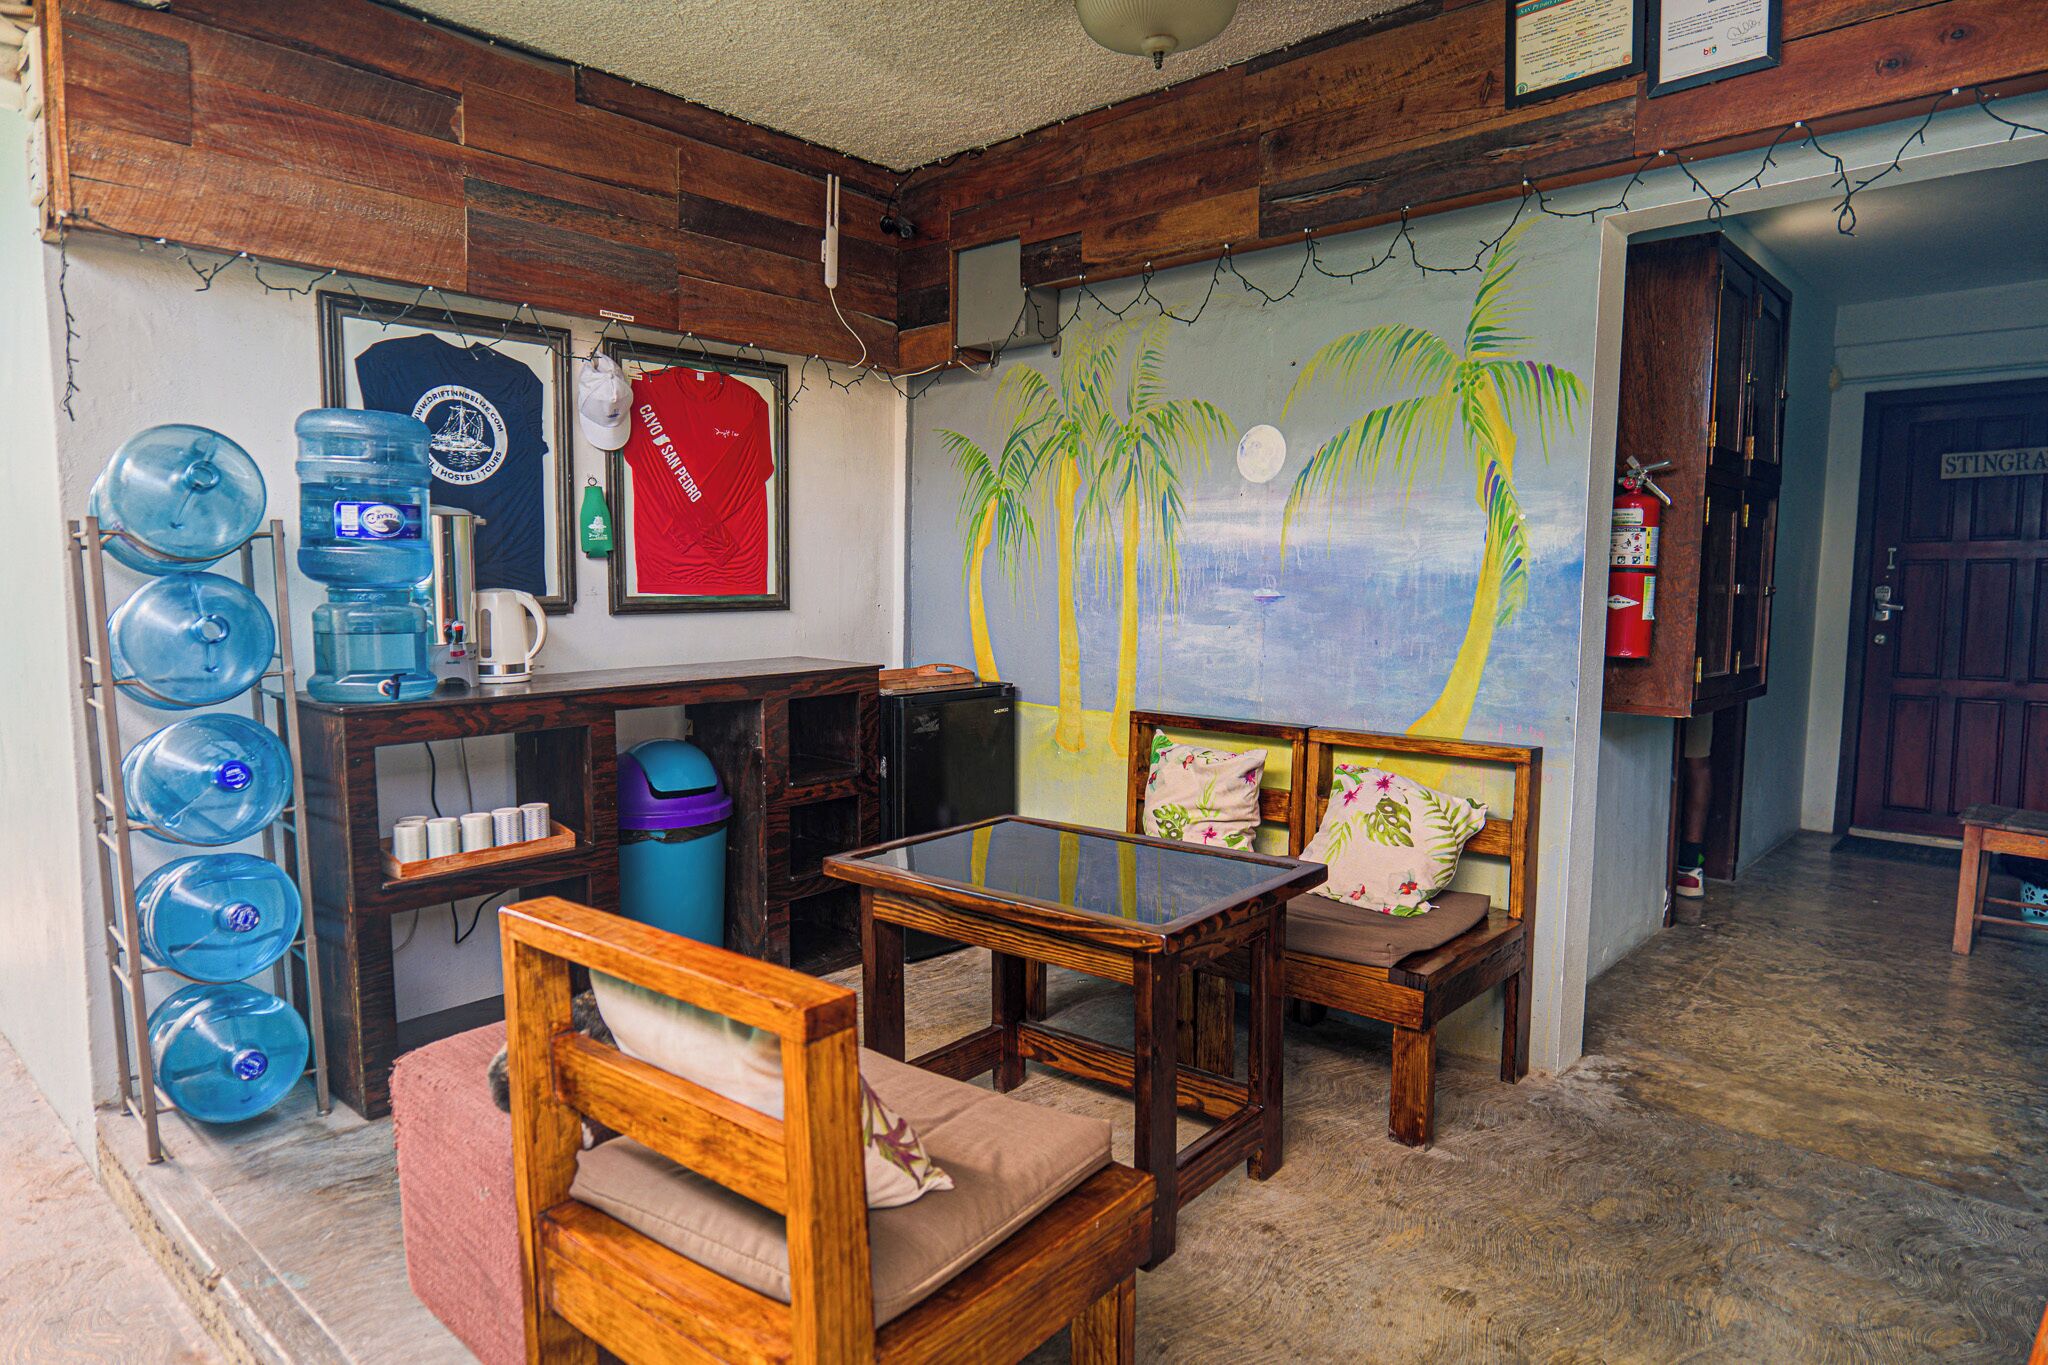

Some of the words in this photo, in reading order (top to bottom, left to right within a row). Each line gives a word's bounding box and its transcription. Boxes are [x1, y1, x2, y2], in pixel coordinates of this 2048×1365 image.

[639, 403, 664, 436] CAYO
[480, 450, 503, 476] TOURS
[661, 444, 683, 471] SAN
[674, 466, 703, 503] PEDRO
[1945, 448, 2048, 474] STINGRA
[440, 469, 476, 481] HOSTEL
